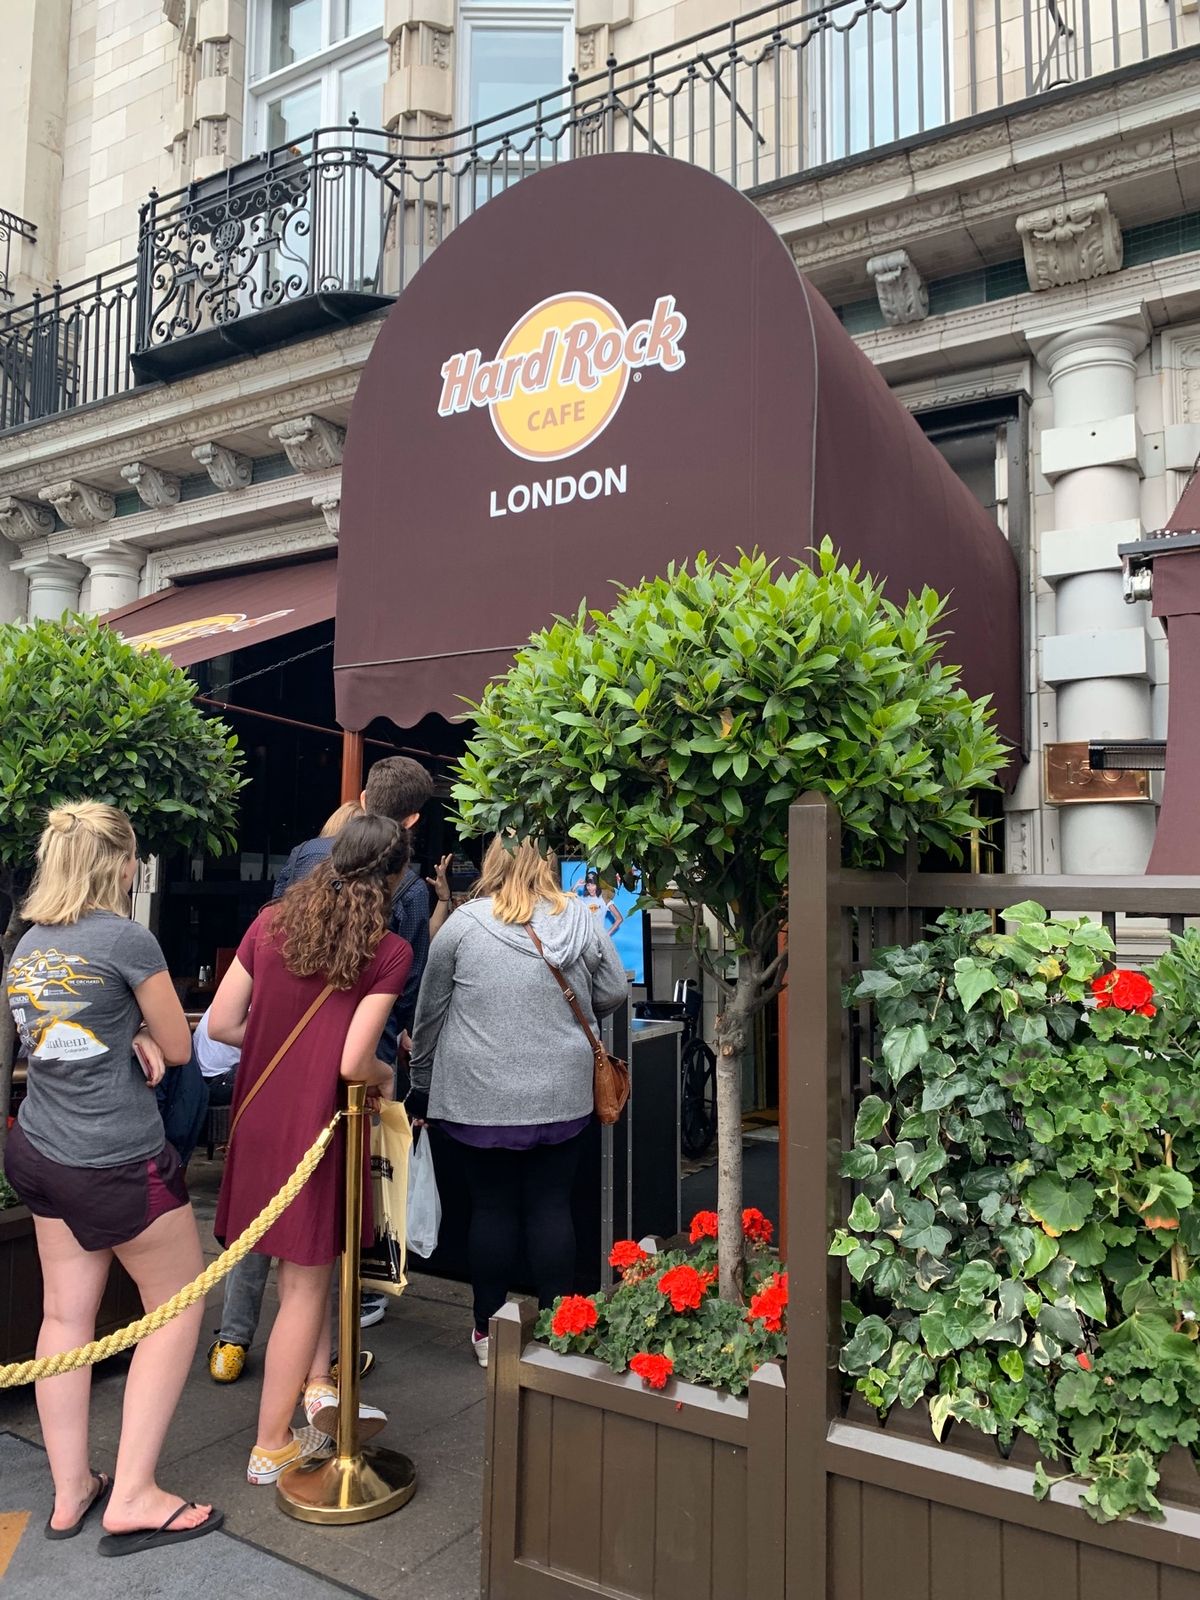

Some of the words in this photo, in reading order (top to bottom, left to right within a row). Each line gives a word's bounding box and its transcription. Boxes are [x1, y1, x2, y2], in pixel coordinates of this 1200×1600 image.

[438, 327, 559, 417] Hard
[560, 294, 687, 391] Rock
[527, 400, 586, 432] CAFE
[489, 464, 628, 518] LONDON
